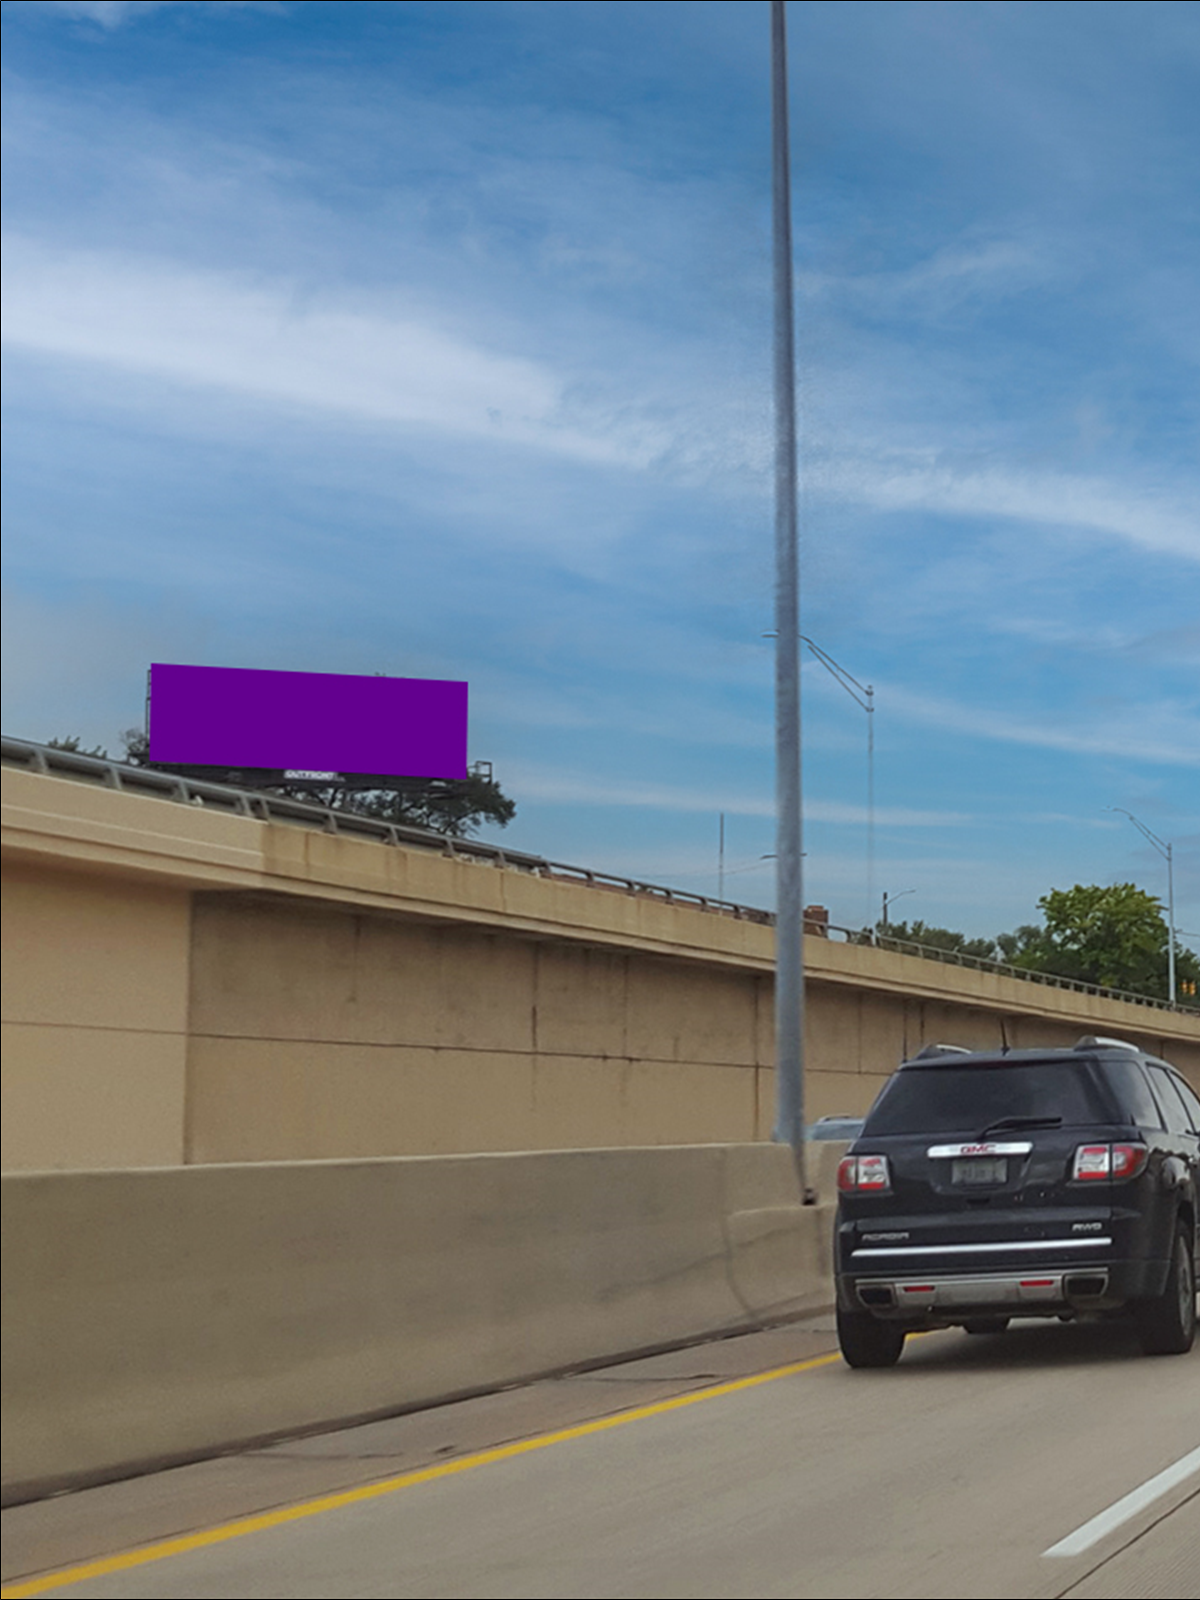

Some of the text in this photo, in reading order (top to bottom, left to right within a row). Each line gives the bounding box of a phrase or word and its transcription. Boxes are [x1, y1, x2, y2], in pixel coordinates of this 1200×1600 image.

[960, 1144, 997, 1155] GMC
[1072, 1222, 1103, 1232] AWD
[861, 1232, 910, 1241] ACADIA
